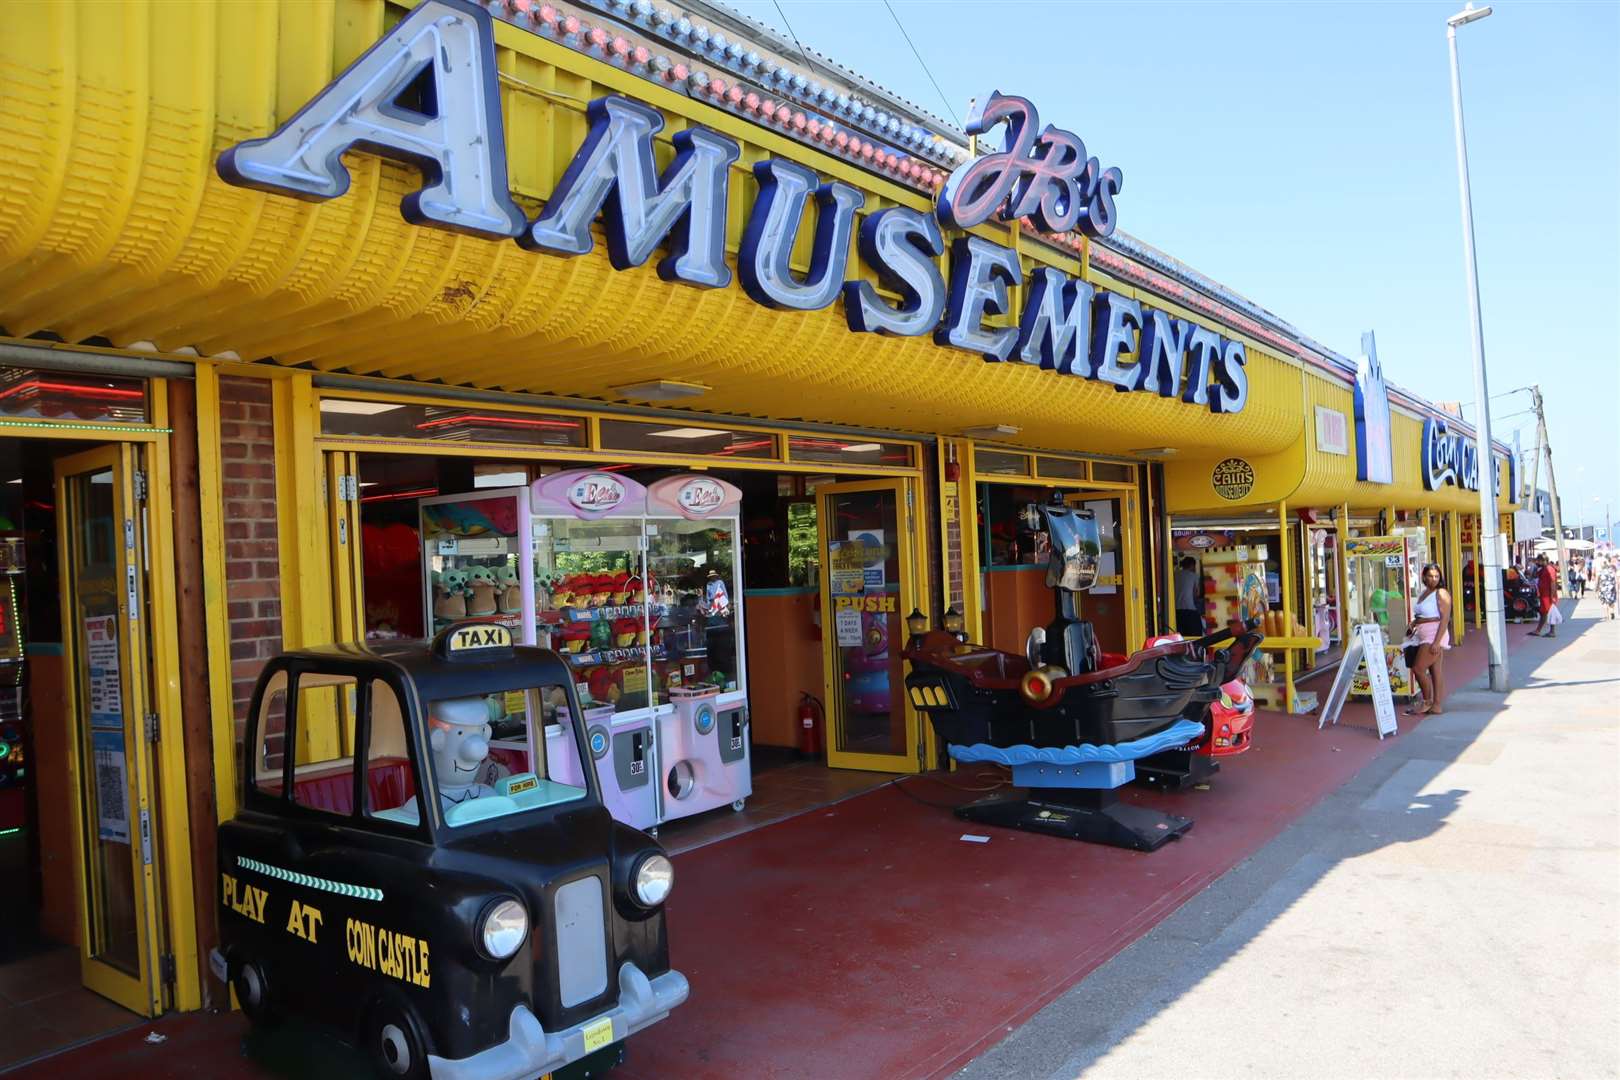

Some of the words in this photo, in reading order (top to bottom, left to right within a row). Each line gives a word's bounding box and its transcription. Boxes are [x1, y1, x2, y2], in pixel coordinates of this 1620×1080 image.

[216, 0, 1248, 414] AMUSEMENTS
[1213, 472, 1253, 485] CAINS
[836, 597, 896, 613] PUSH
[458, 629, 503, 647] TAXI
[222, 873, 269, 924] PLAY
[286, 900, 323, 944] AT
[346, 918, 376, 970] COIN
[378, 928, 430, 988] CASTLE
